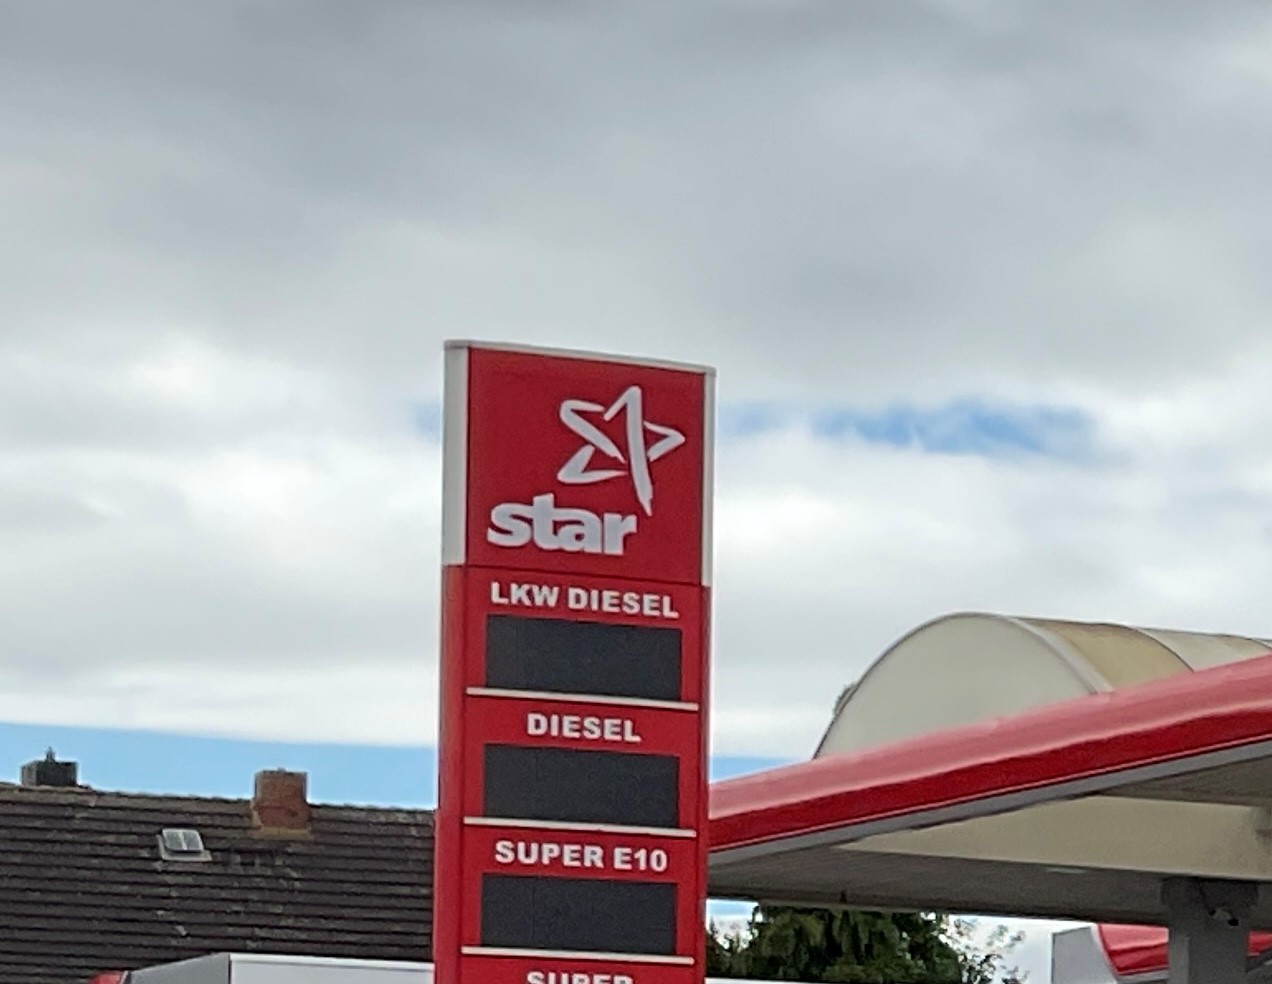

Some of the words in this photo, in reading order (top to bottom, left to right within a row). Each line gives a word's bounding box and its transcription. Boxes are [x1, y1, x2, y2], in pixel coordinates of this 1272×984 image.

[487, 493, 637, 556] star
[491, 582, 559, 609] LKW
[567, 585, 680, 619] DIESEL
[527, 713, 641, 743] DIESEL
[495, 840, 605, 869] SUPER
[614, 845, 668, 872] E10
